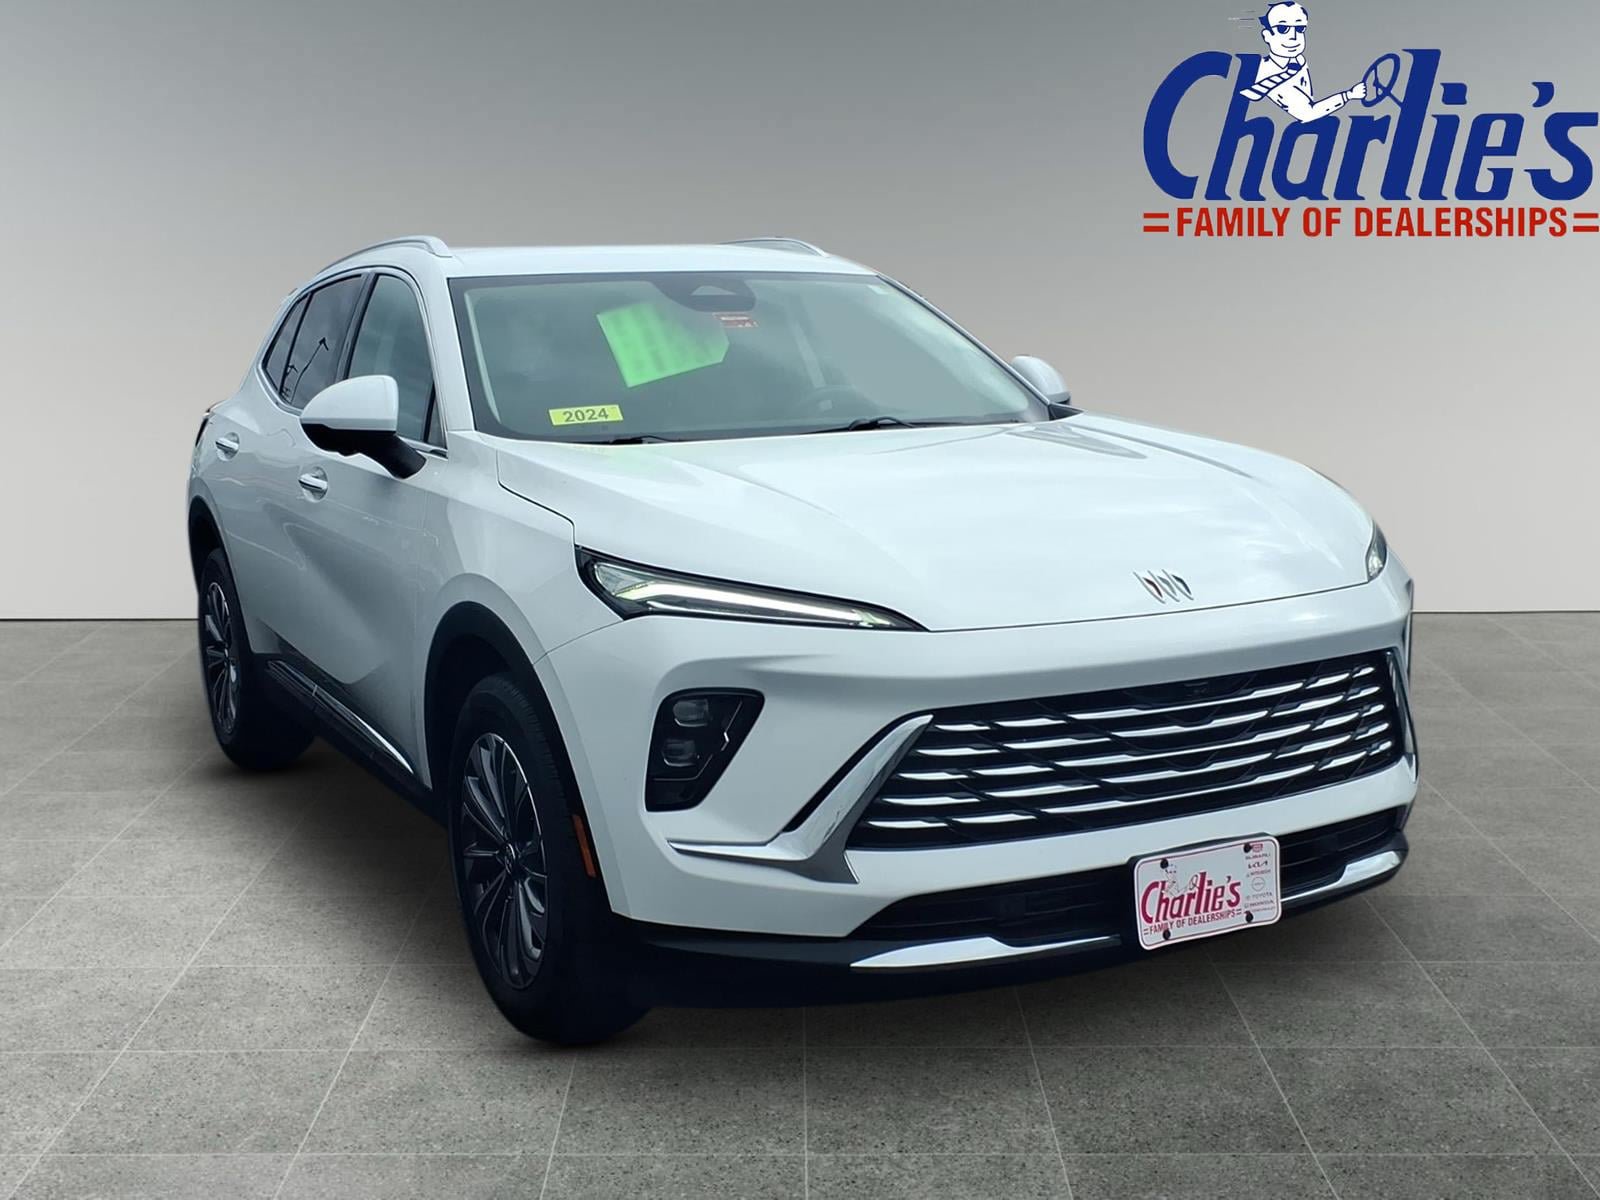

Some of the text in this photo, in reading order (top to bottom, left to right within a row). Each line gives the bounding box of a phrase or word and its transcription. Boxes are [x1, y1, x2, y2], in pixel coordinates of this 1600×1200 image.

[562, 408, 610, 424] 2024
[1142, 872, 1240, 924] Charlie's
[1149, 921, 1176, 934] FAMILY
[1176, 918, 1186, 928] OF
[1188, 908, 1237, 925] DEALERSHIPS
